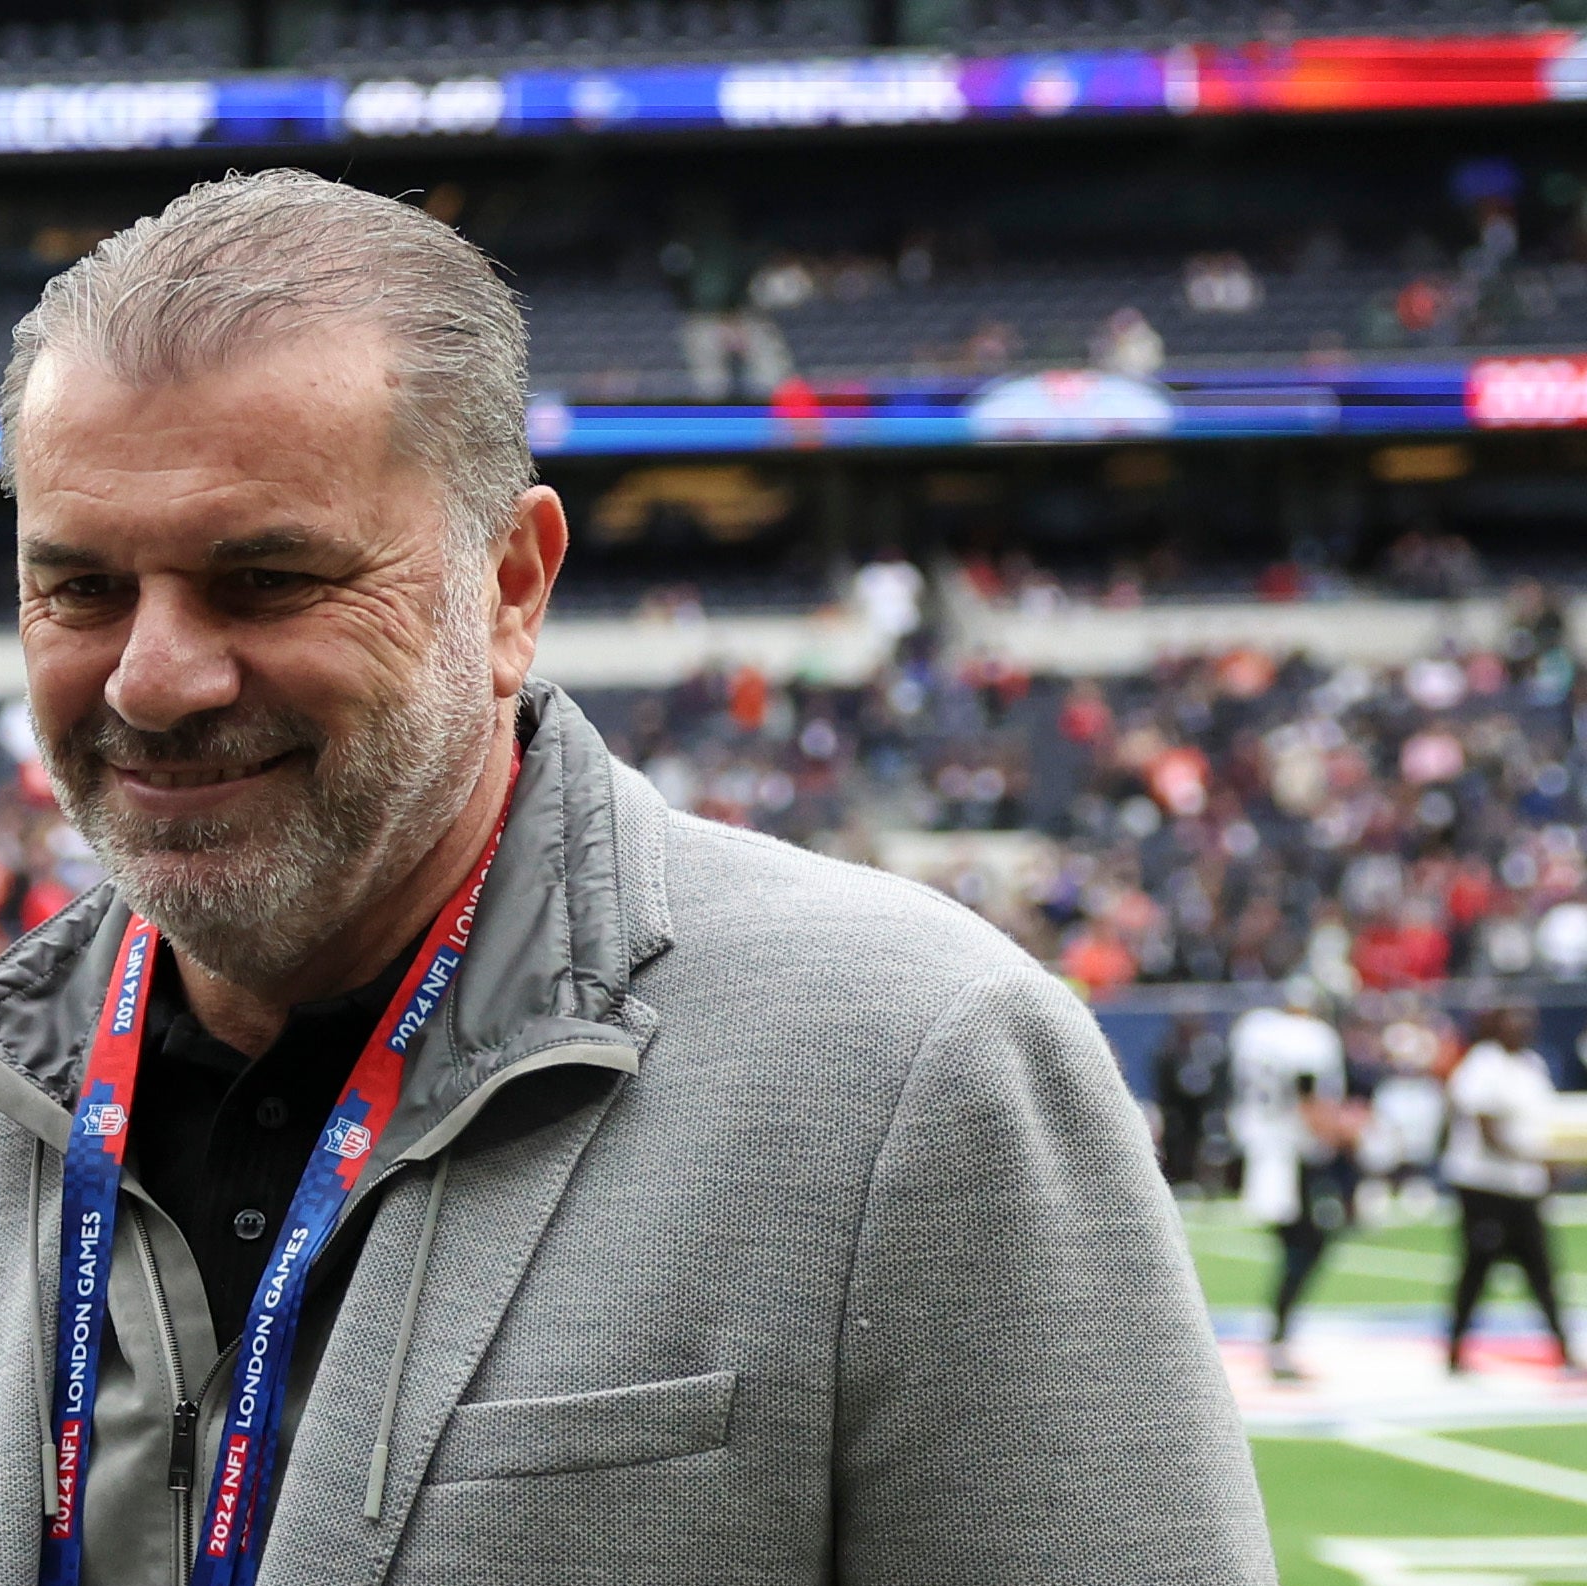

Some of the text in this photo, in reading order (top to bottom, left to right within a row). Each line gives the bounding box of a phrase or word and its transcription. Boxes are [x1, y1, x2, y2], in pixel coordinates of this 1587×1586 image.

[124, 935, 148, 980] NFL
[113, 980, 138, 1033] 2024
[391, 996, 433, 1050] 2024
[422, 955, 460, 997] NFL
[100, 1105, 120, 1132] NFL
[341, 1130, 366, 1154] NFL
[52, 1211, 101, 1534] 2024 NFL LONDON GAMES
[210, 1227, 309, 1553] 2024 NFL LONDON GAMES
